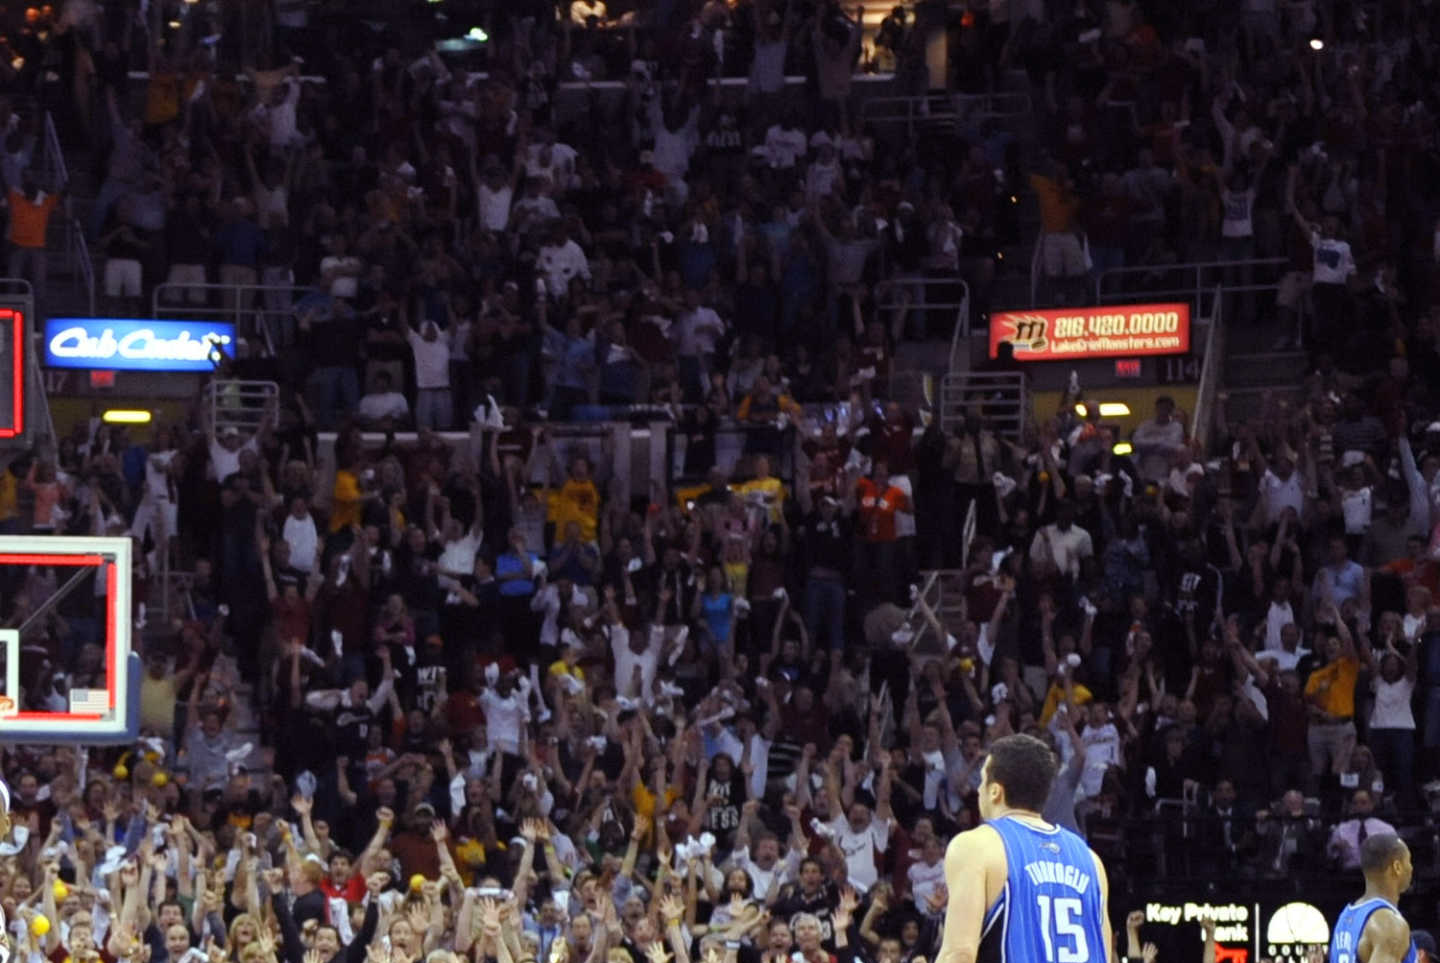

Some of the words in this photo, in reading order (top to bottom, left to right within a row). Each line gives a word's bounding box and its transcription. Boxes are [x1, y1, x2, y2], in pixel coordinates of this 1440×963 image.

[1037, 895, 1090, 963] 15
[1146, 902, 1182, 926] Key
[1183, 902, 1249, 922] Private
